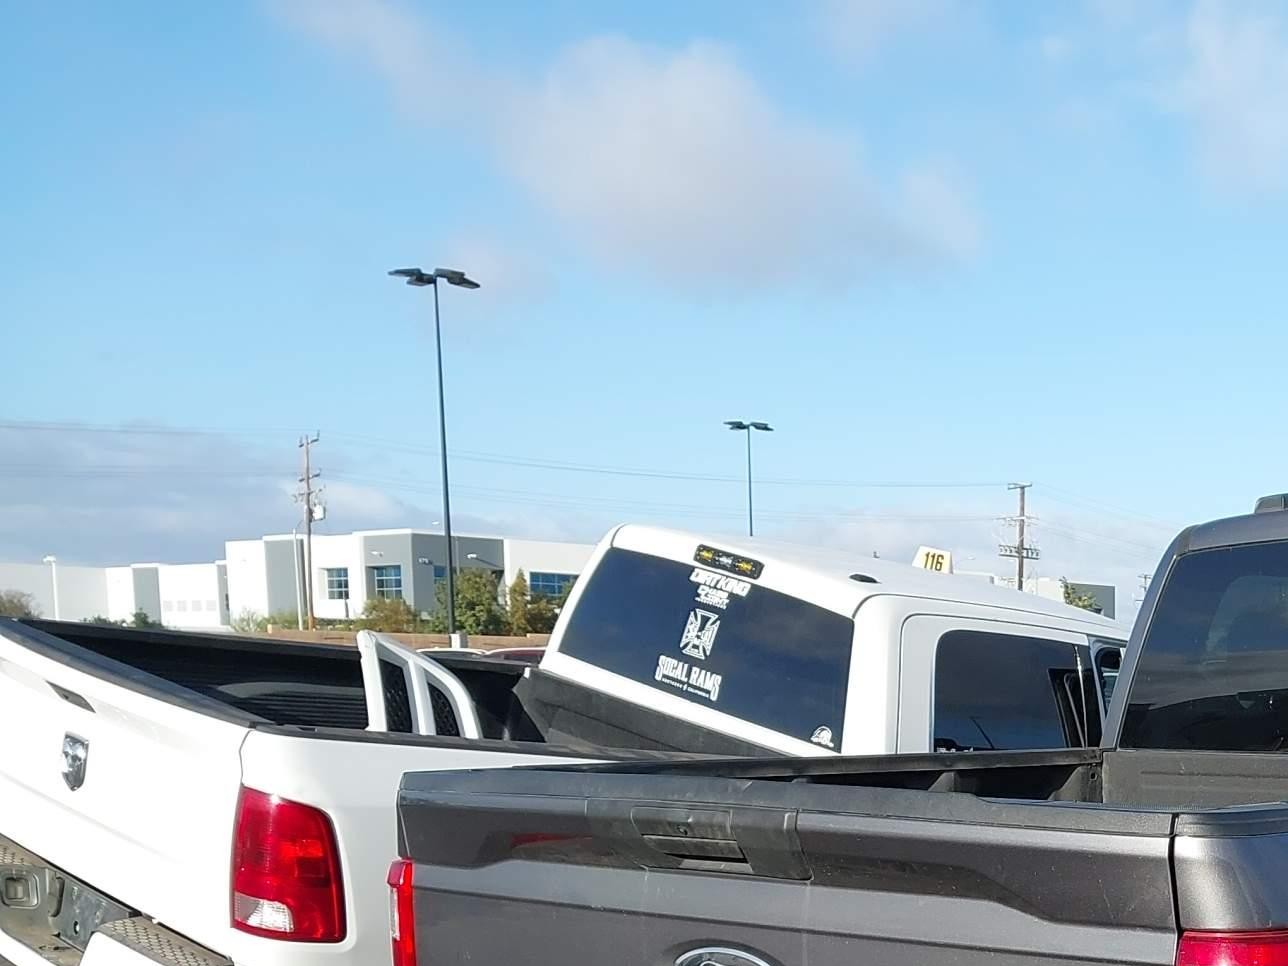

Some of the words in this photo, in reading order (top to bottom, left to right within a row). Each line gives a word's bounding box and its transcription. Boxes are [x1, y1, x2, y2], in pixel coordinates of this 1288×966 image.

[923, 551, 945, 572] 116
[654, 655, 689, 682] SOCAL
[689, 666, 722, 701] RAMS
